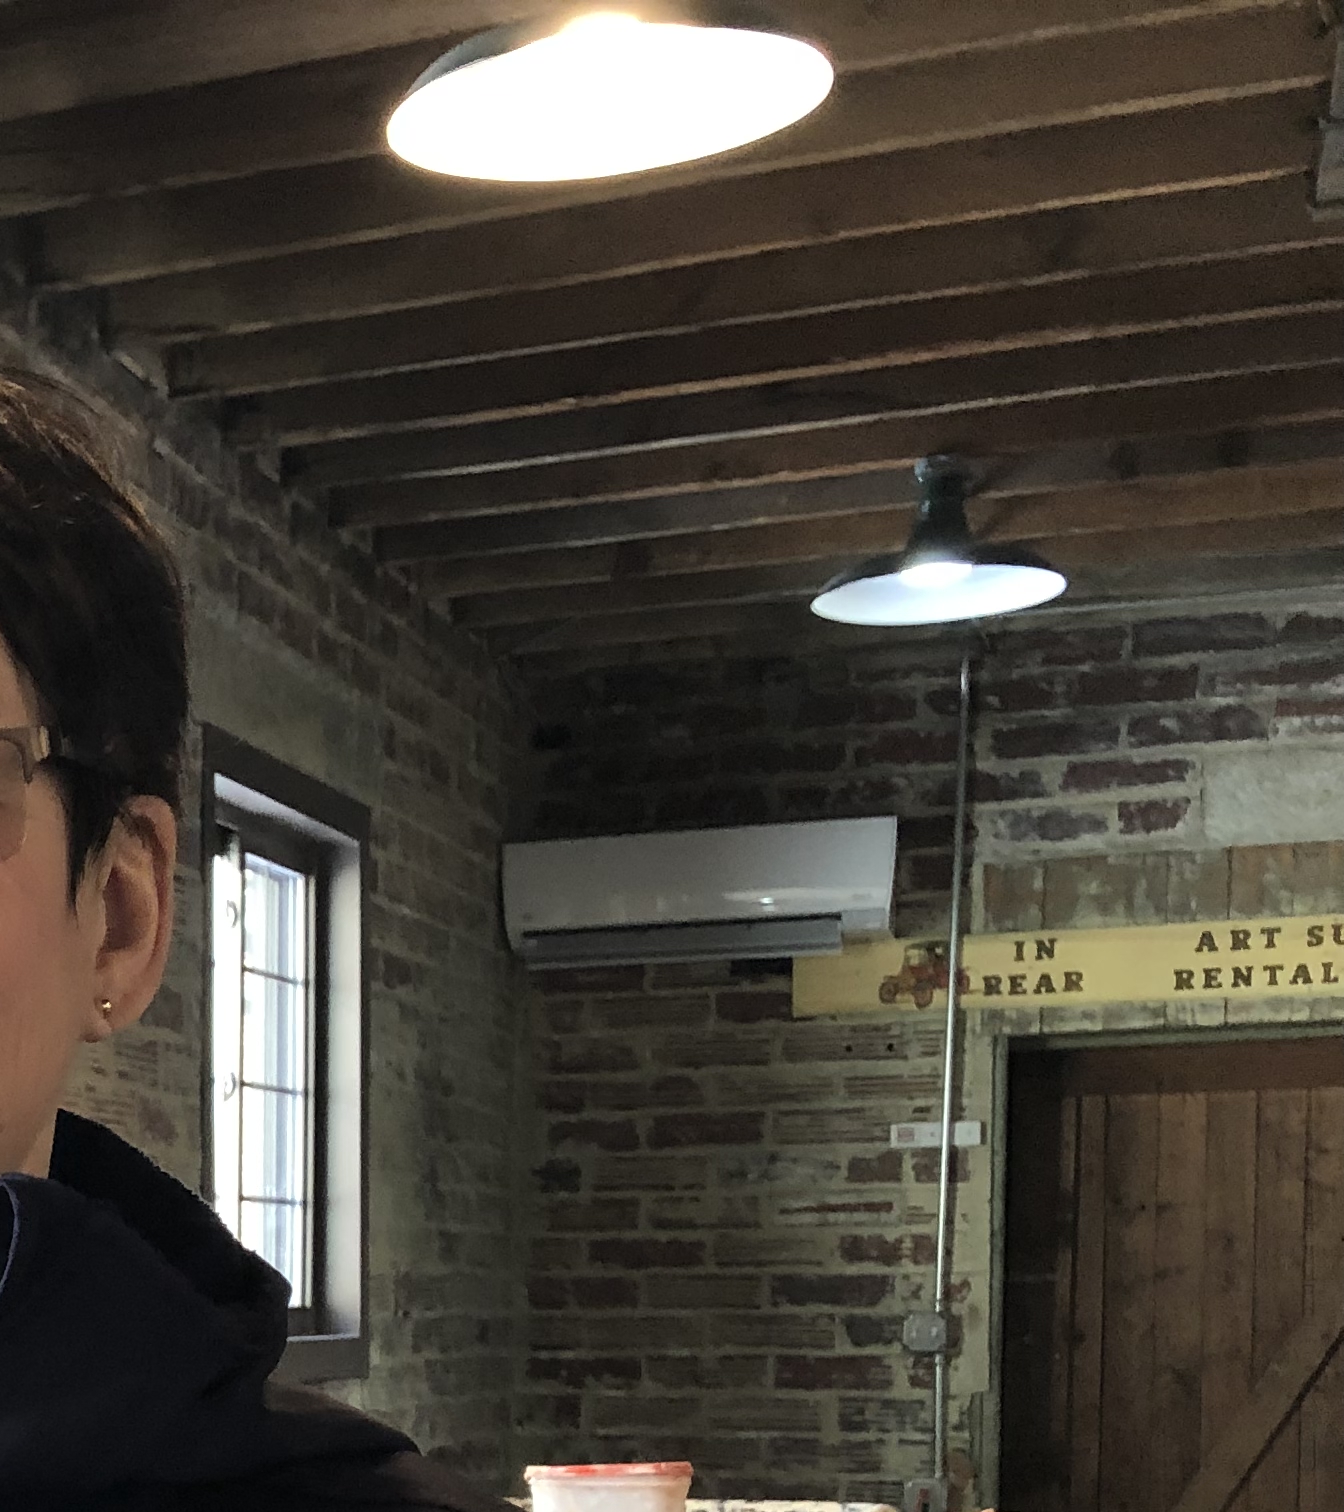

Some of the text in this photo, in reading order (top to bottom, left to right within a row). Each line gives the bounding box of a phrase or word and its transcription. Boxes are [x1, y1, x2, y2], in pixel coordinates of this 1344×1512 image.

[1013, 938, 1057, 962] IN
[1194, 926, 1282, 952] ART
[982, 971, 1084, 996] REAR
[1173, 961, 1340, 991] RENTAL
